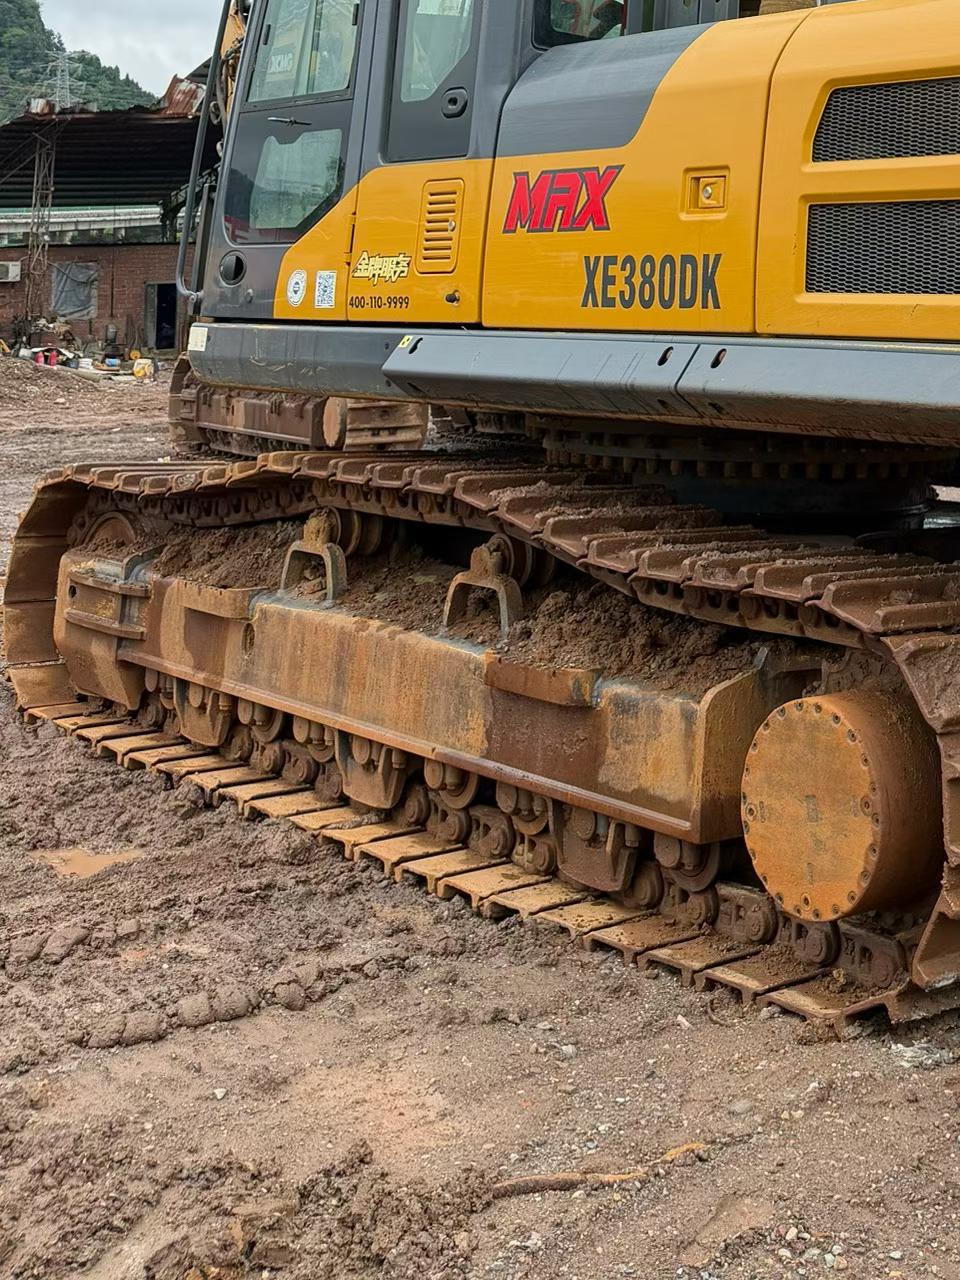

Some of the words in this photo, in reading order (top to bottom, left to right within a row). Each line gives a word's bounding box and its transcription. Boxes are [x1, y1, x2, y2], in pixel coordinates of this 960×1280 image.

[502, 163, 626, 234] MAX
[352, 250, 412, 287] 金牌服务
[580, 252, 723, 310] XE380DK
[349, 295, 410, 309] 400-110-9999
